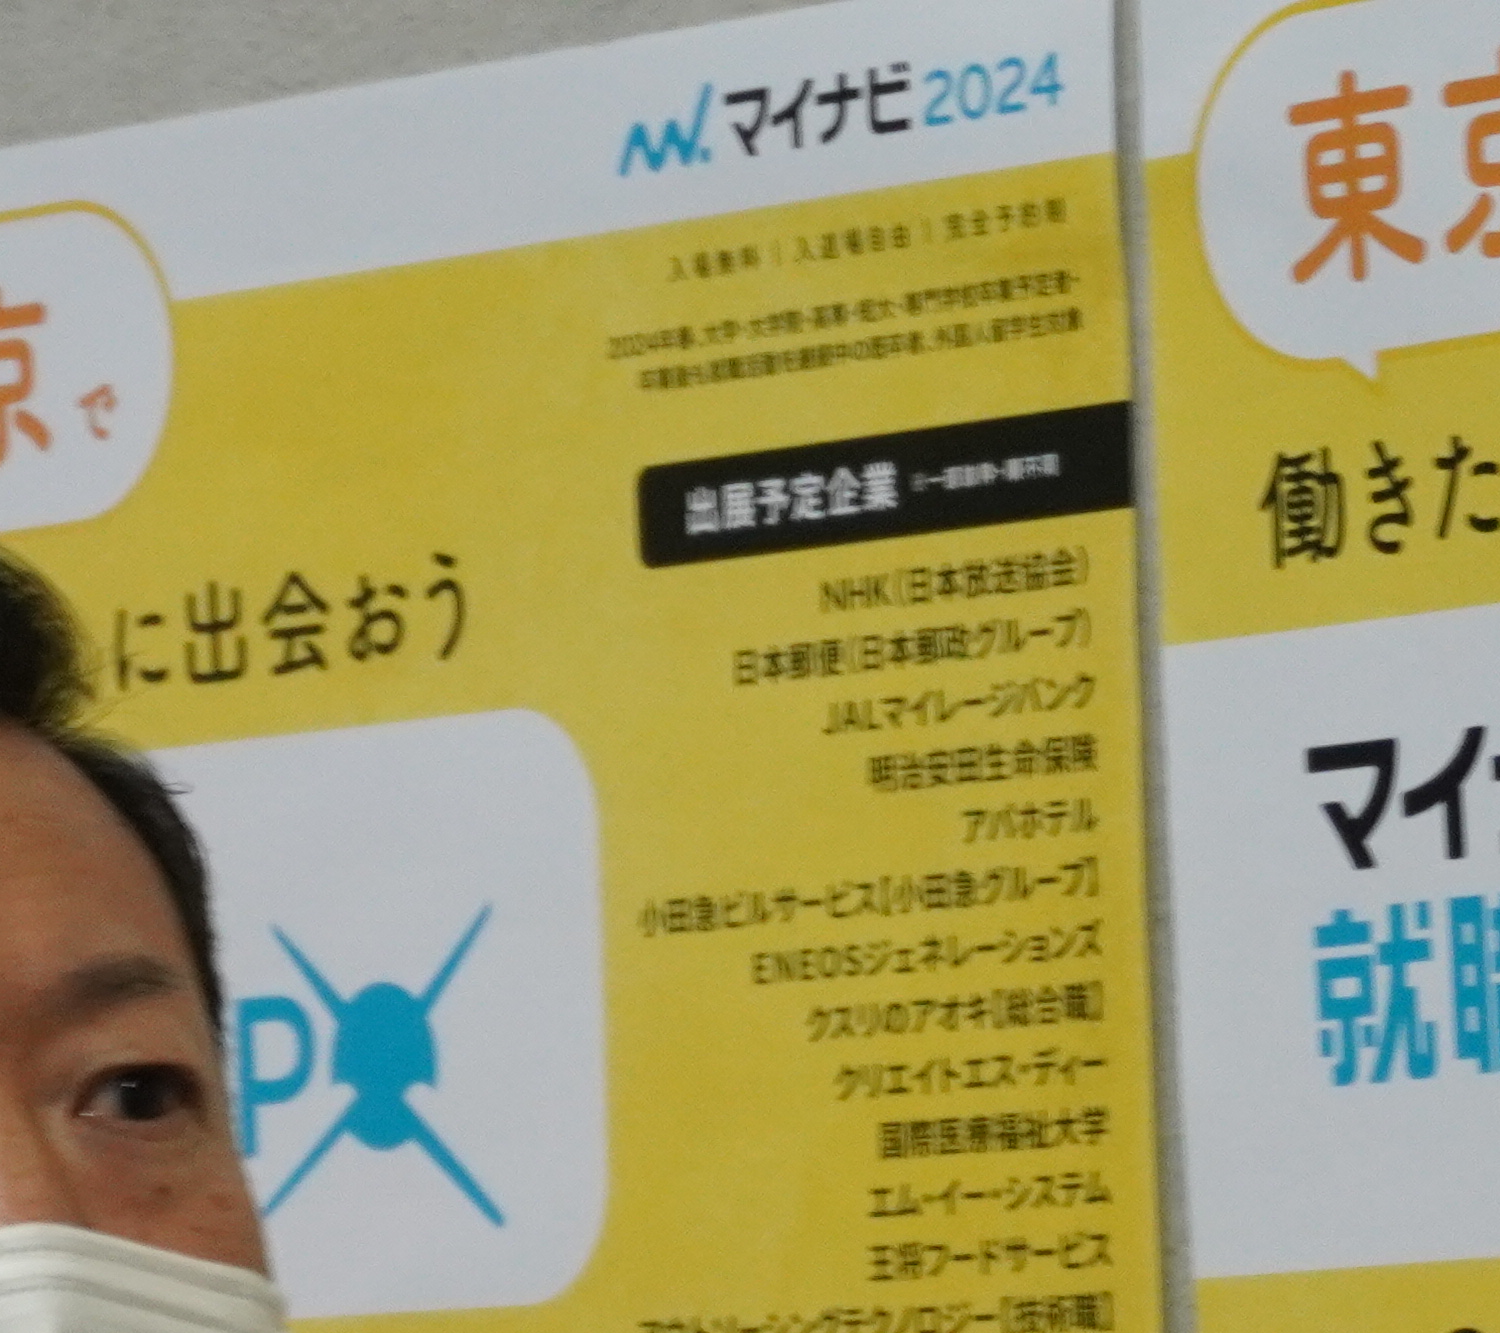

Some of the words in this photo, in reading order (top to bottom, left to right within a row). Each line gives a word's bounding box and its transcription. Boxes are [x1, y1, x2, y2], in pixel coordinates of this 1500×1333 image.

[723, 52, 1065, 156] マイナビ2024
[684, 461, 899, 536] 出展予定企業
[818, 547, 1091, 614] NHK(日本放送協会)
[114, 553, 468, 690] に出会おう
[733, 608, 1091, 686] 日本郵便(日本郵政グループ)
[822, 673, 1097, 735] JALマイレージバンク
[867, 733, 1099, 791] 明治安田生命保険
[963, 799, 1099, 843] アパホテル
[752, 919, 1103, 985] ENEOSジェネレーションズ
[877, 1107, 1109, 1159] 国際医療福祉大学
[867, 1232, 1114, 1282] 王将フードサービス
